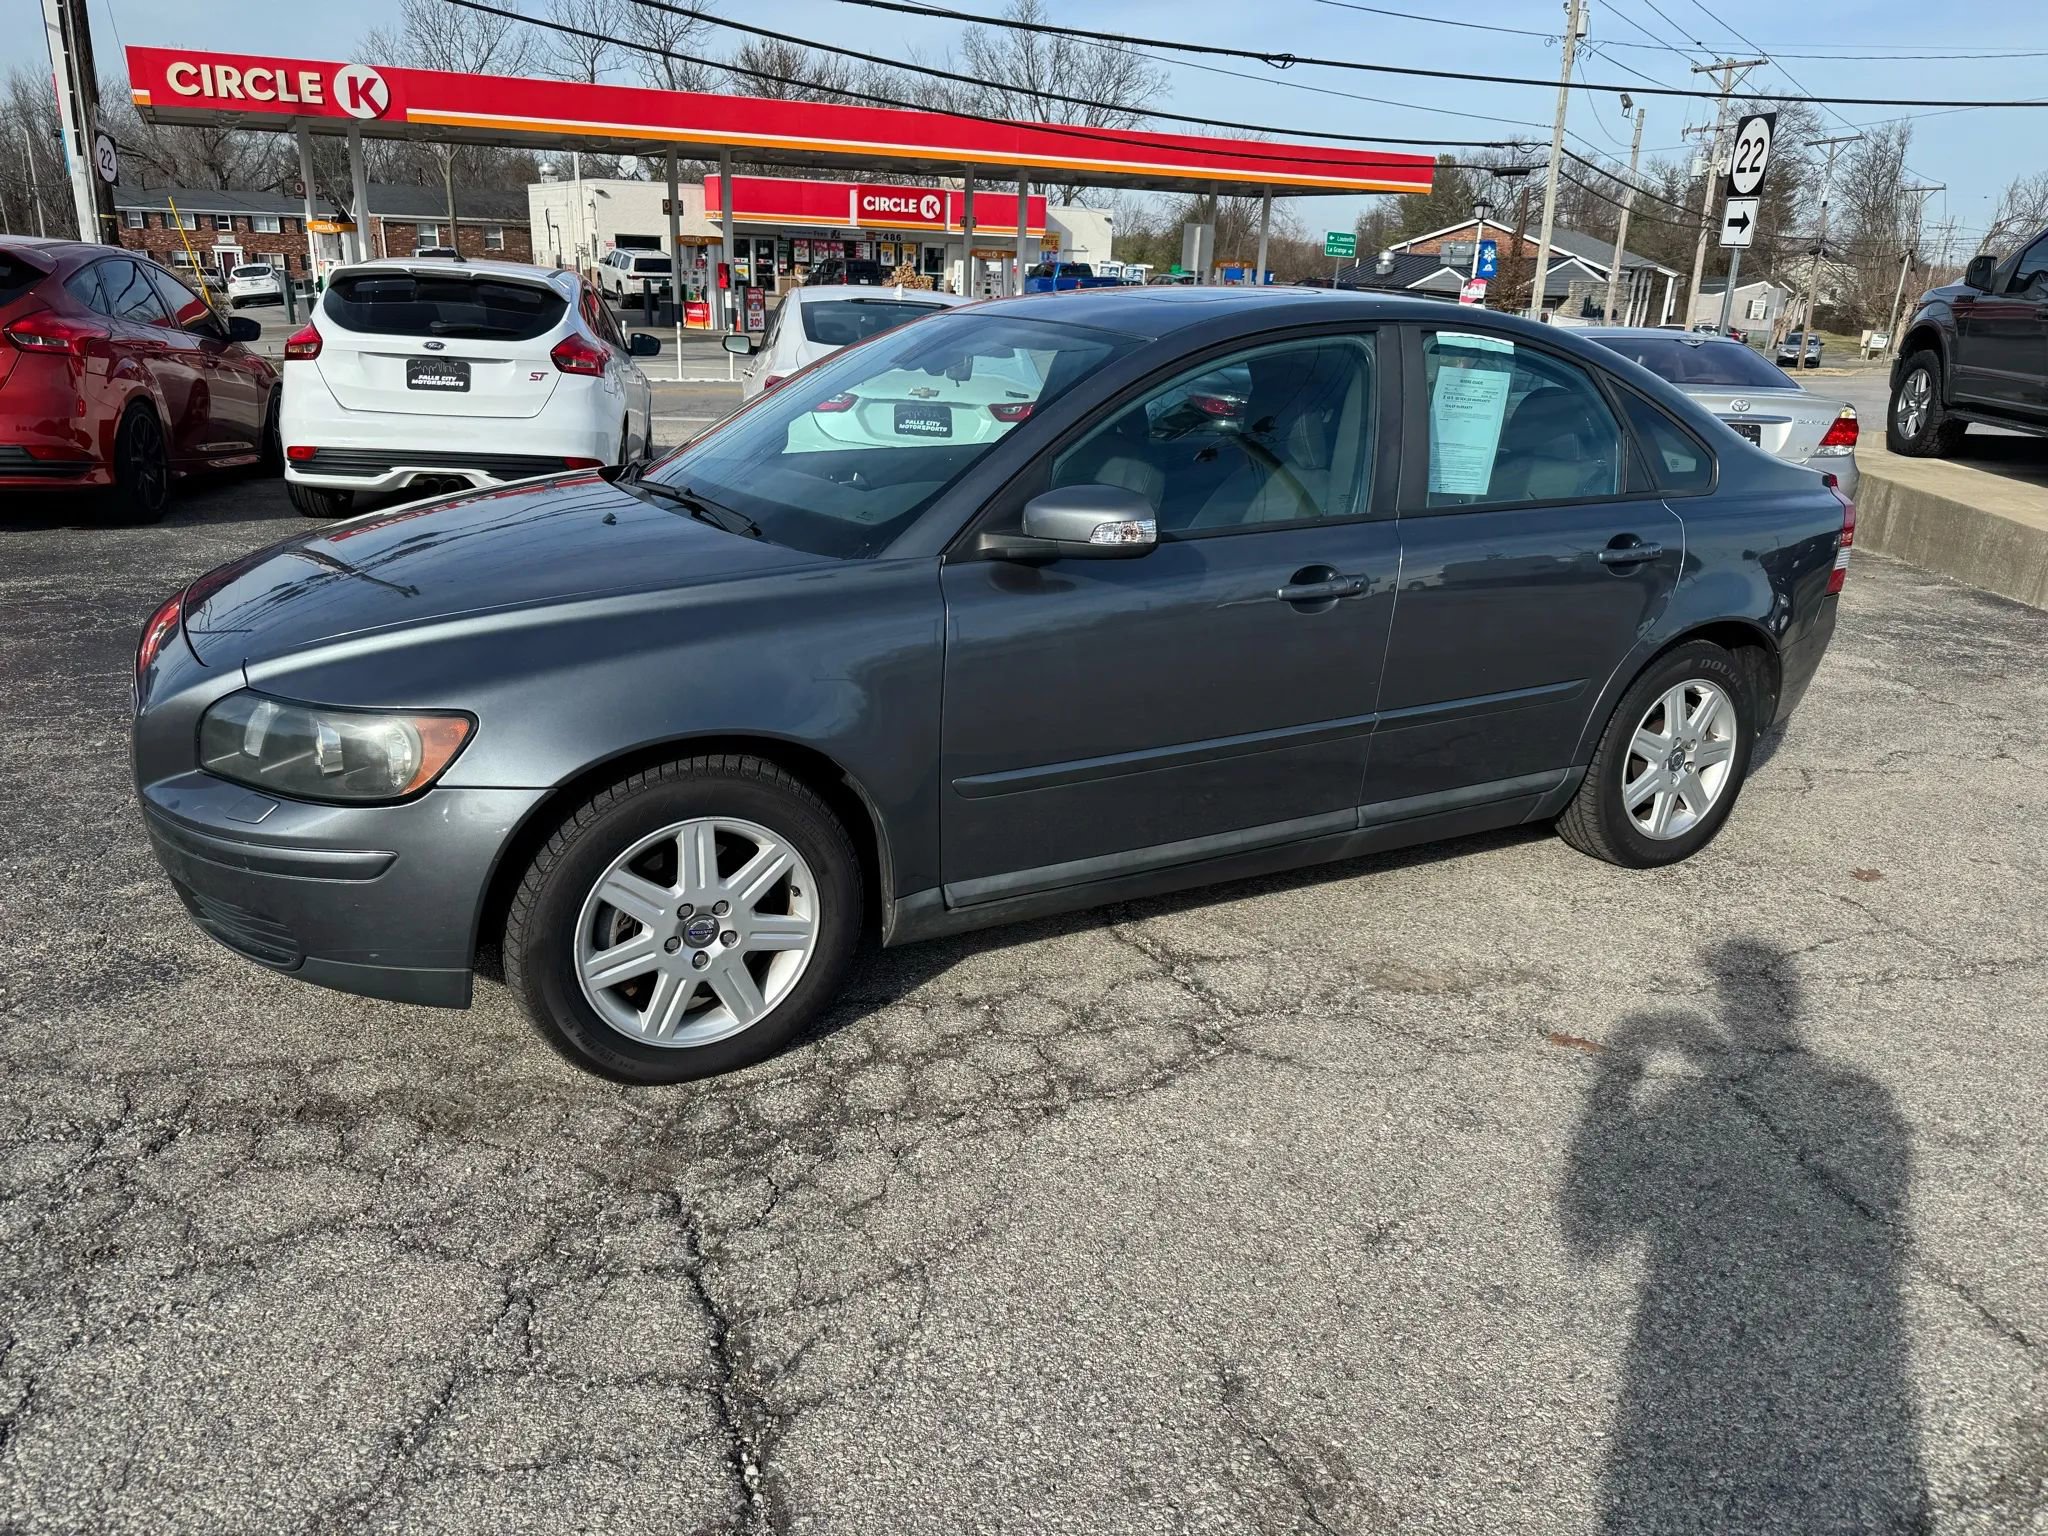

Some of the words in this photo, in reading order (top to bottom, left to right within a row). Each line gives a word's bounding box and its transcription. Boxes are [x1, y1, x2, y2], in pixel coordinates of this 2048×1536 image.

[166, 61, 324, 105] CIRCLE
[101, 148, 113, 172] 22
[1736, 137, 1765, 173] 22
[863, 196, 917, 213] CIRCLE
[883, 233, 901, 242] 486
[411, 379, 465, 387] MOTORSPORTS
[529, 372, 549, 381] ST
[899, 423, 948, 432] MOTORSPORTS
